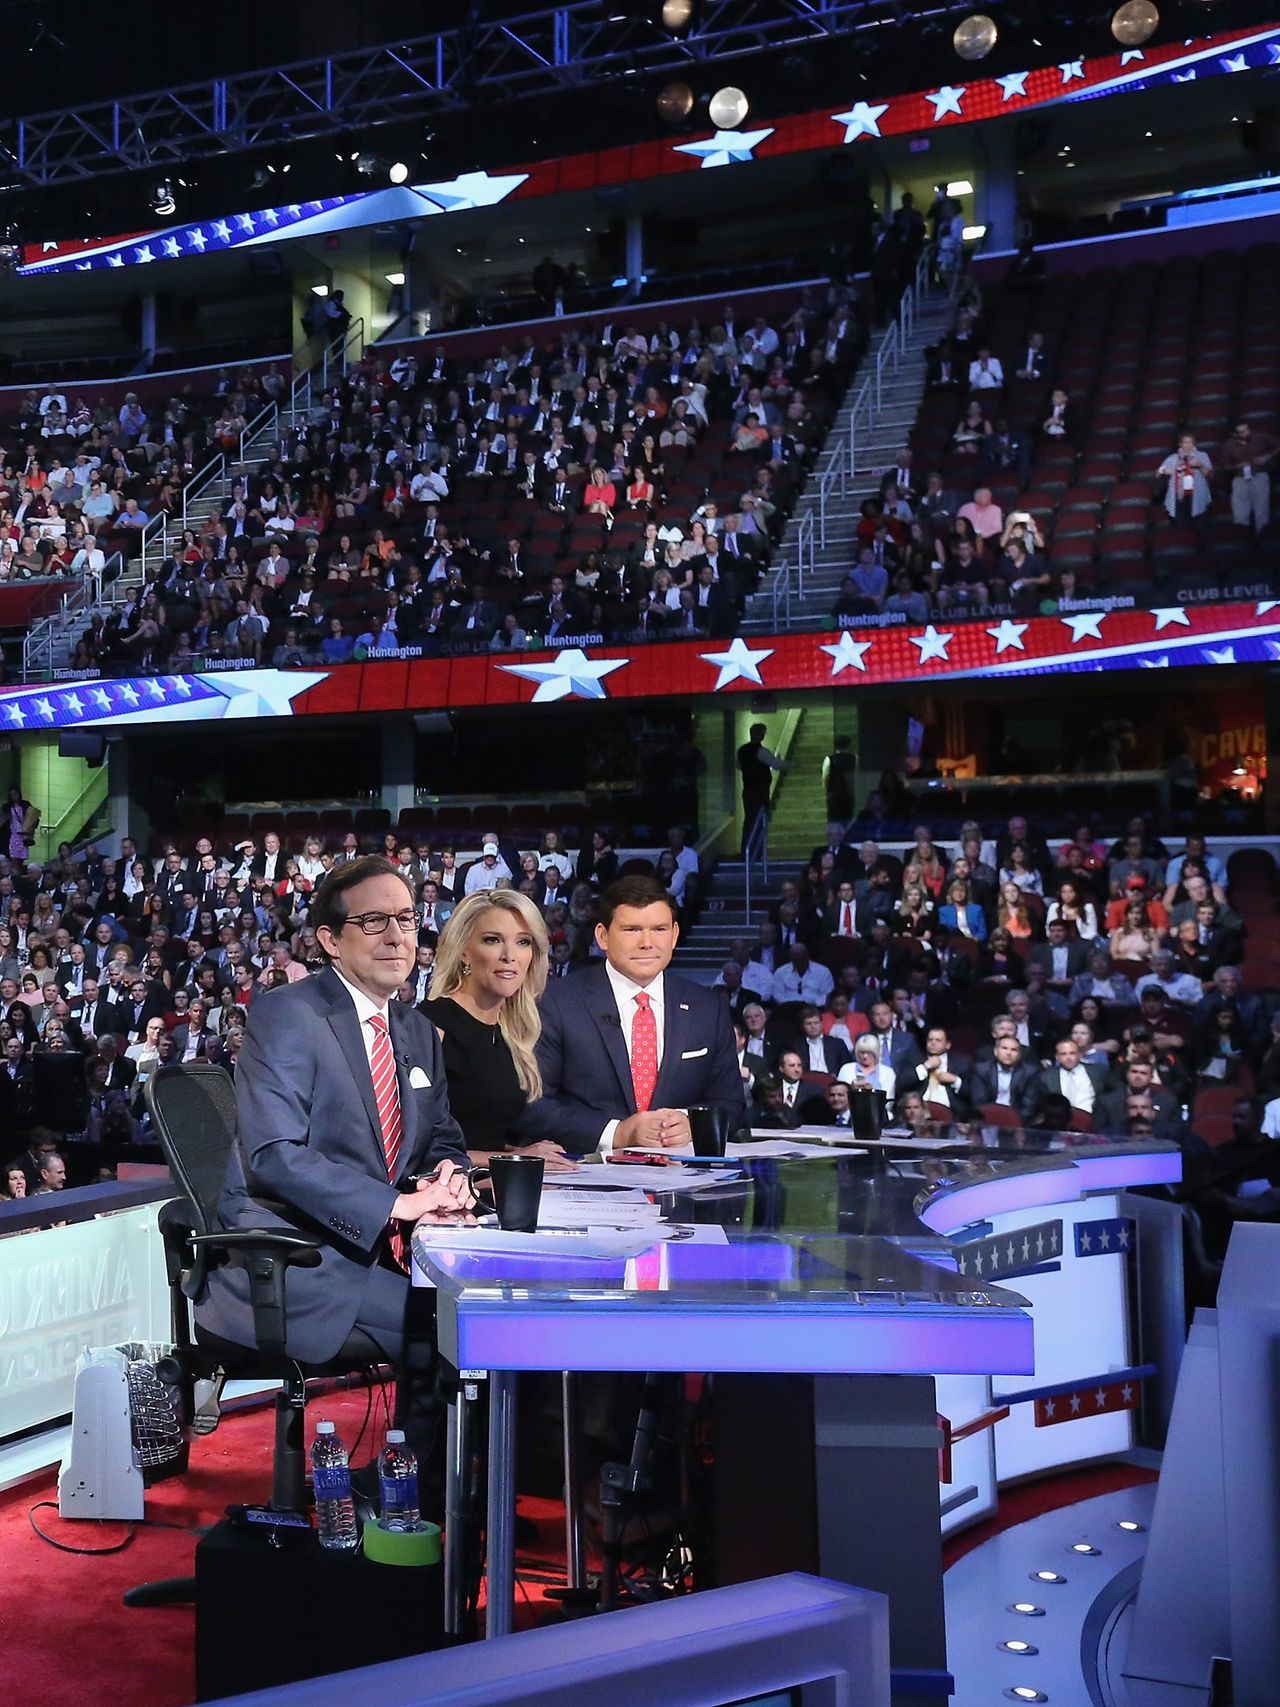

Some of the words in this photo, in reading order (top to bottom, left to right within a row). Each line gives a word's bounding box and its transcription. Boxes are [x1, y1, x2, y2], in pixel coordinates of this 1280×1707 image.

[1177, 588, 1220, 602] CLUB
[1224, 583, 1273, 598] LEVEL
[930, 606, 967, 619] CLUB
[970, 603, 1016, 617] LEVEL
[1058, 595, 1135, 612] Huntington
[838, 611, 907, 627] Huntington
[544, 632, 603, 647] Huntington
[367, 645, 423, 659] Huntington
[205, 657, 256, 670] Huntington
[53, 668, 101, 680] Huntington
